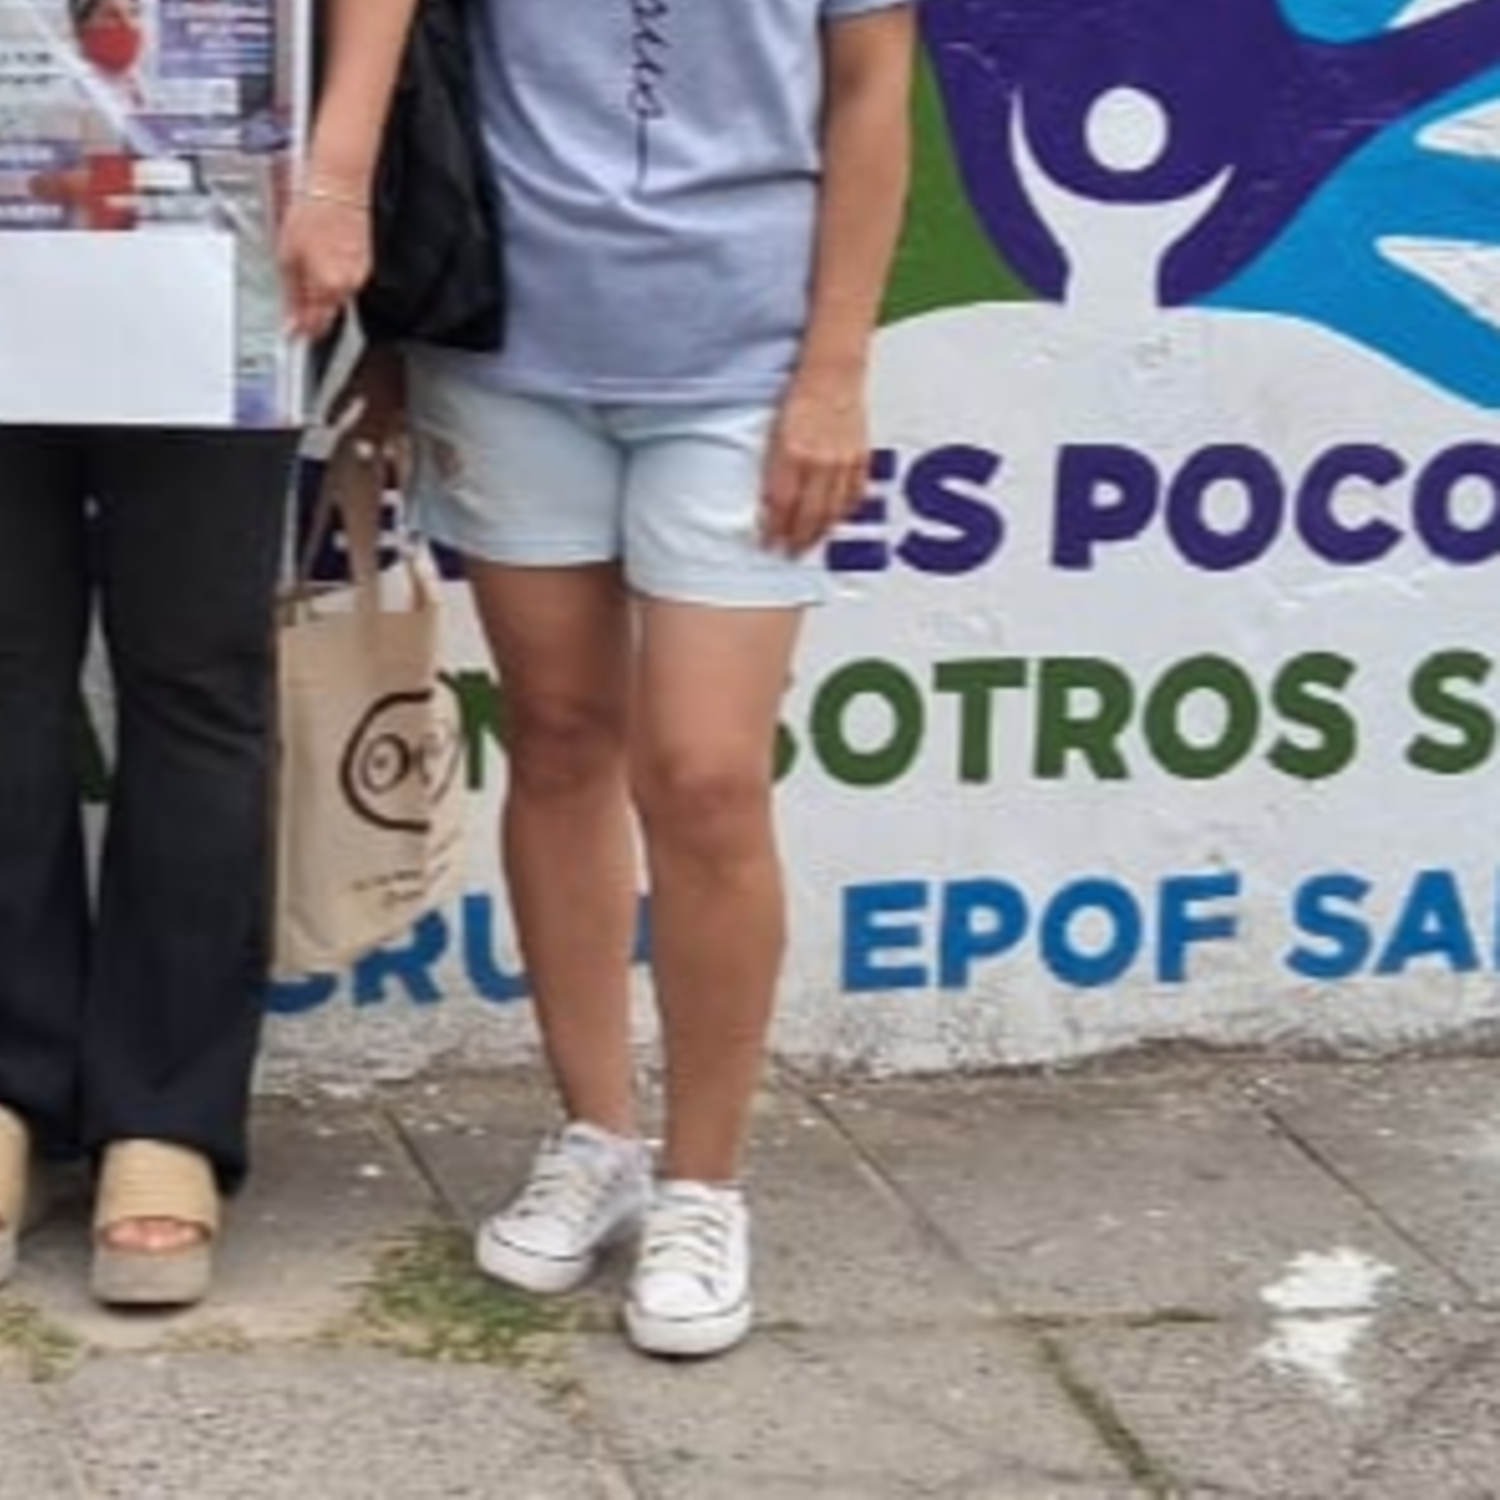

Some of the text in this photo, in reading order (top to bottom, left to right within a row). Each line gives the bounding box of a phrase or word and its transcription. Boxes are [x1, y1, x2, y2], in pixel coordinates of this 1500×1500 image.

[1050, 442, 1500, 572] POCO
[841, 872, 1243, 994] EPOF
[1284, 869, 1500, 981] SA
